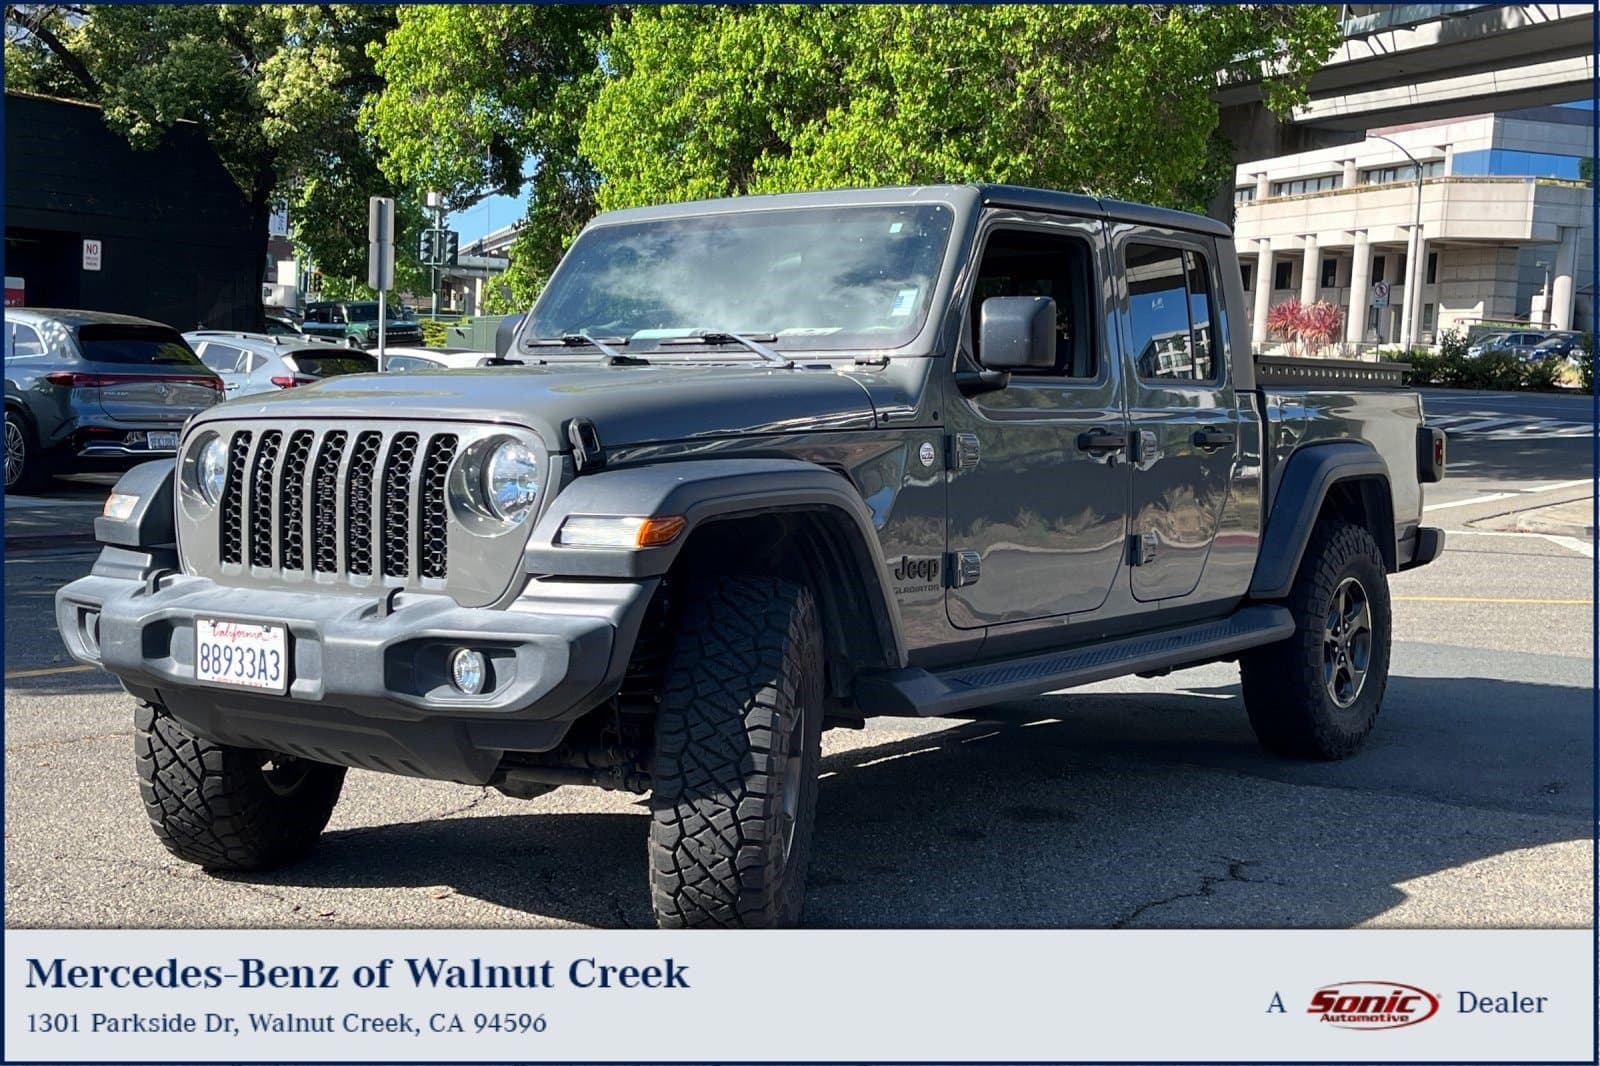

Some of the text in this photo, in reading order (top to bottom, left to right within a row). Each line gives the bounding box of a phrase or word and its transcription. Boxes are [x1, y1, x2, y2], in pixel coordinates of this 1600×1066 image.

[86, 243, 98, 255] NO
[895, 555, 939, 582] Jeep
[200, 642, 280, 681] 88933A3
